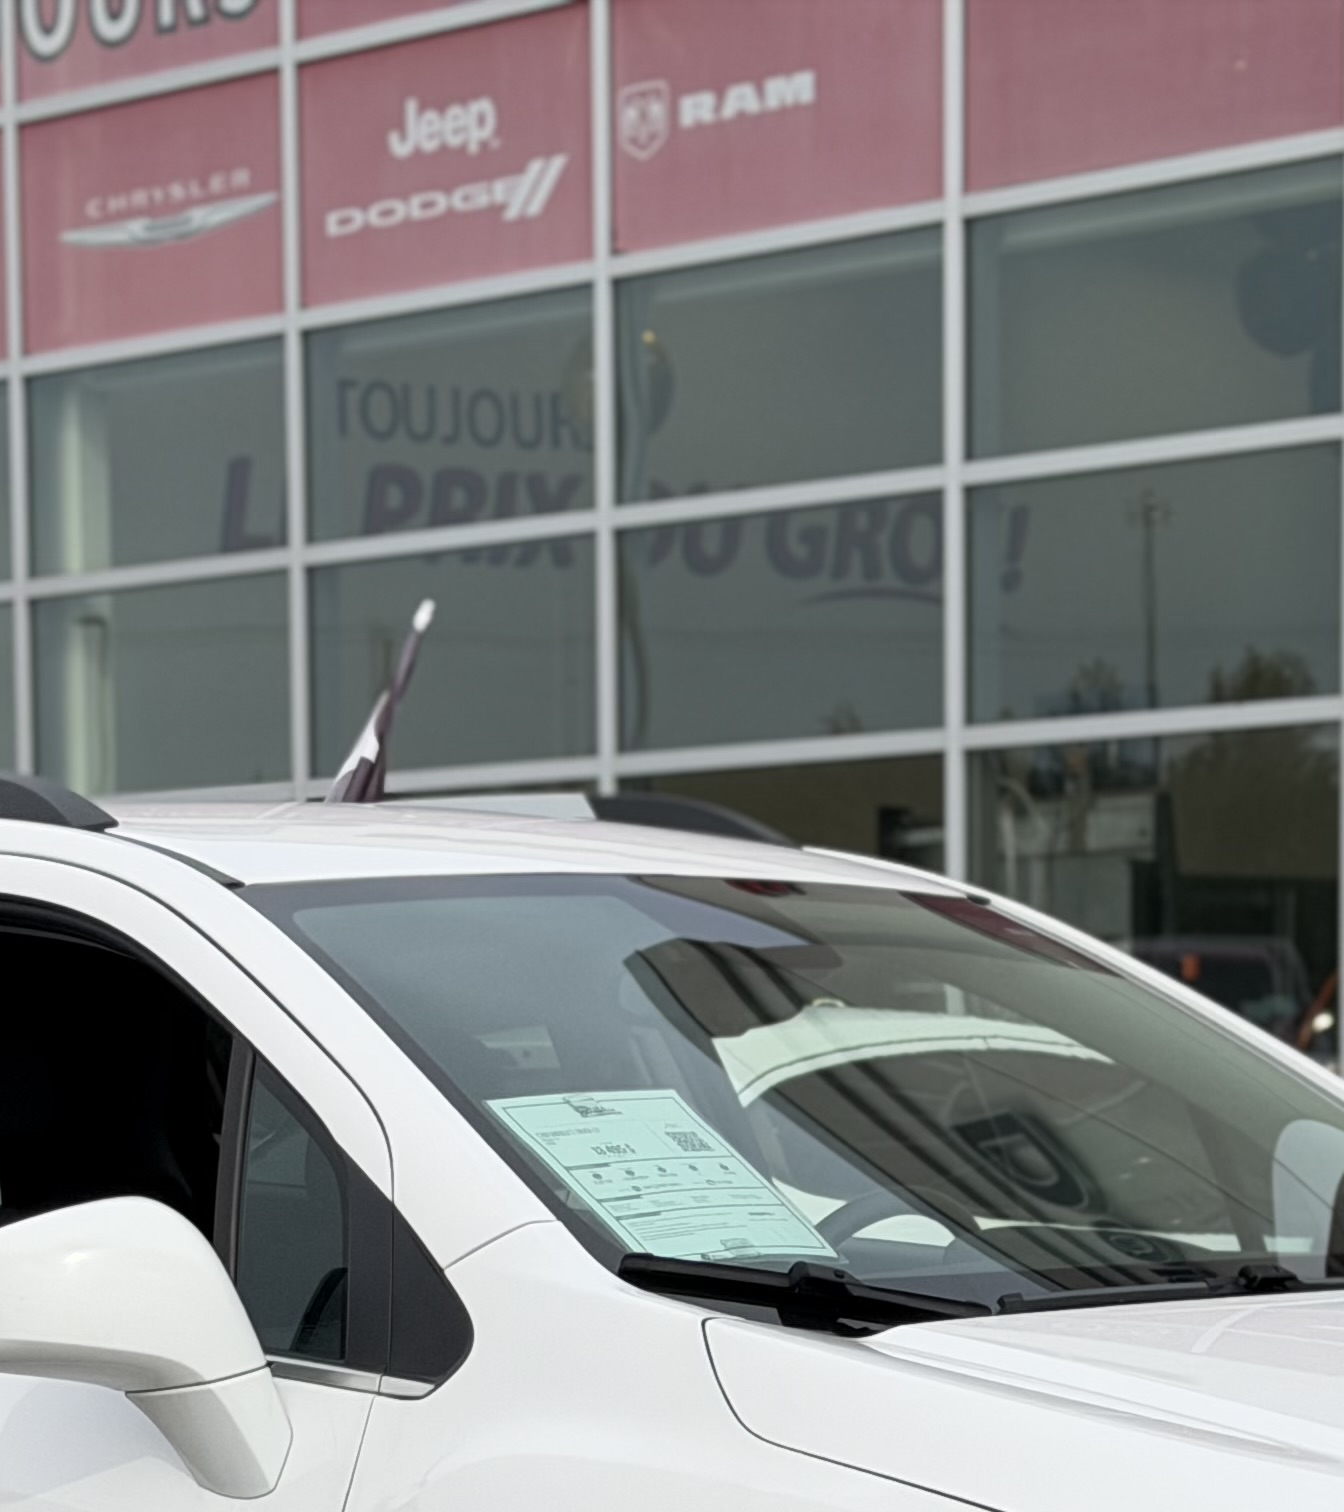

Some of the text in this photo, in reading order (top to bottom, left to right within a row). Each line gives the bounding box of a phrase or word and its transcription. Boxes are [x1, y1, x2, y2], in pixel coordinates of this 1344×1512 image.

[388, 97, 497, 159] Jeep
[679, 70, 816, 128] RAM
[85, 167, 252, 219] CHRYSLER
[325, 173, 524, 237] DODGE
[337, 376, 594, 451] TOUJOUR
[222, 453, 286, 554] L
[362, 463, 582, 569] PRIX
[764, 490, 944, 586] GRO
